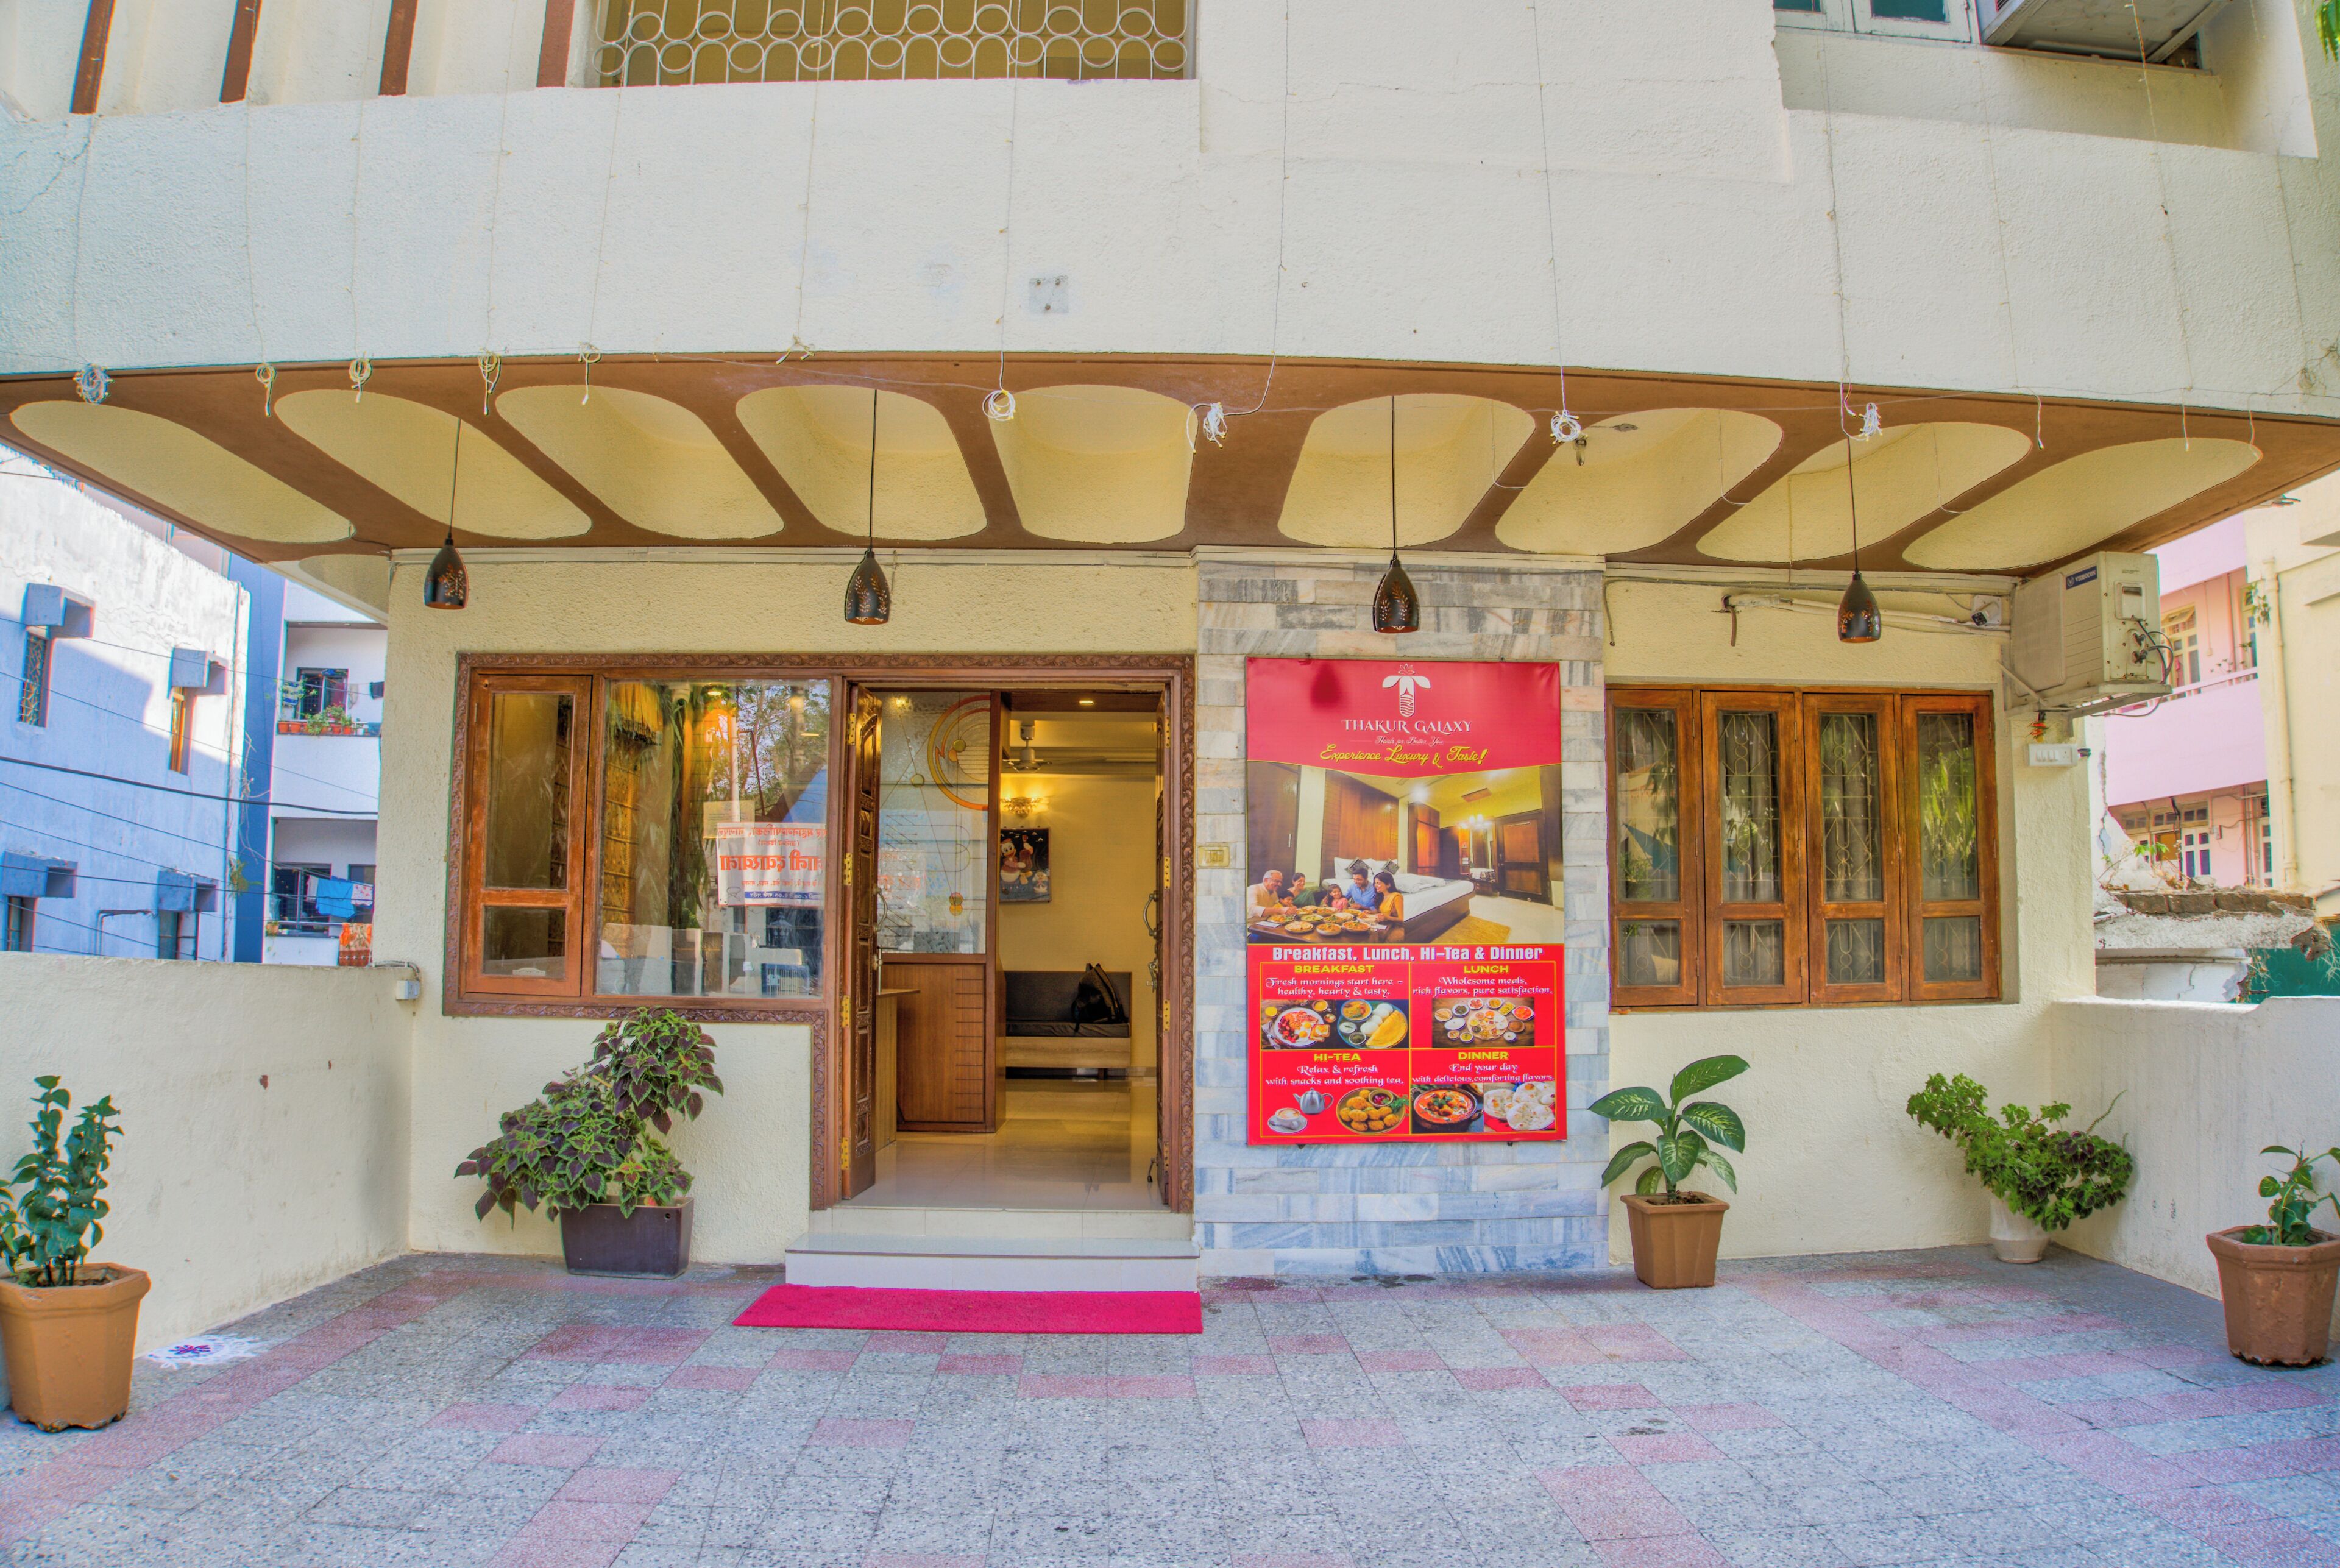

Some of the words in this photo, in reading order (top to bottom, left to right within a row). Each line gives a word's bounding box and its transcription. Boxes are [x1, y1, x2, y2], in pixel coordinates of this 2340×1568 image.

[1341, 719, 1411, 734] THAKUR
[1414, 720, 1472, 735] GALAXY
[1320, 744, 1381, 762] Experience
[1384, 745, 1429, 765] Luxury
[1433, 753, 1443, 768] &
[1447, 746, 1489, 765] Taste!
[1272, 947, 1357, 961] Breakfast,
[1363, 947, 1415, 961] Lunch,
[1420, 947, 1470, 960] Hi-Tea
[1475, 947, 1484, 960] &
[1491, 947, 1543, 960] Dinner
[1294, 965, 1374, 973] BREAKFAST
[1265, 977, 1297, 987] Fresh
[1300, 979, 1344, 988] mornings
[1439, 977, 1495, 985] Wholesome
[1319, 988, 1350, 997] hearty
[1473, 988, 1495, 996] pure
[1498, 986, 1553, 997] satisfaction.
[1314, 1053, 1361, 1062] HI-TEA
[1458, 1051, 1509, 1060] DINNER
[1297, 1065, 1328, 1076] Relax
[1344, 1065, 1378, 1076] refresh
[1448, 1063, 1472, 1072] End
[1475, 1064, 1497, 1074] your
[1500, 1063, 1518, 1073] day
[1345, 1076, 1384, 1087] soothing
